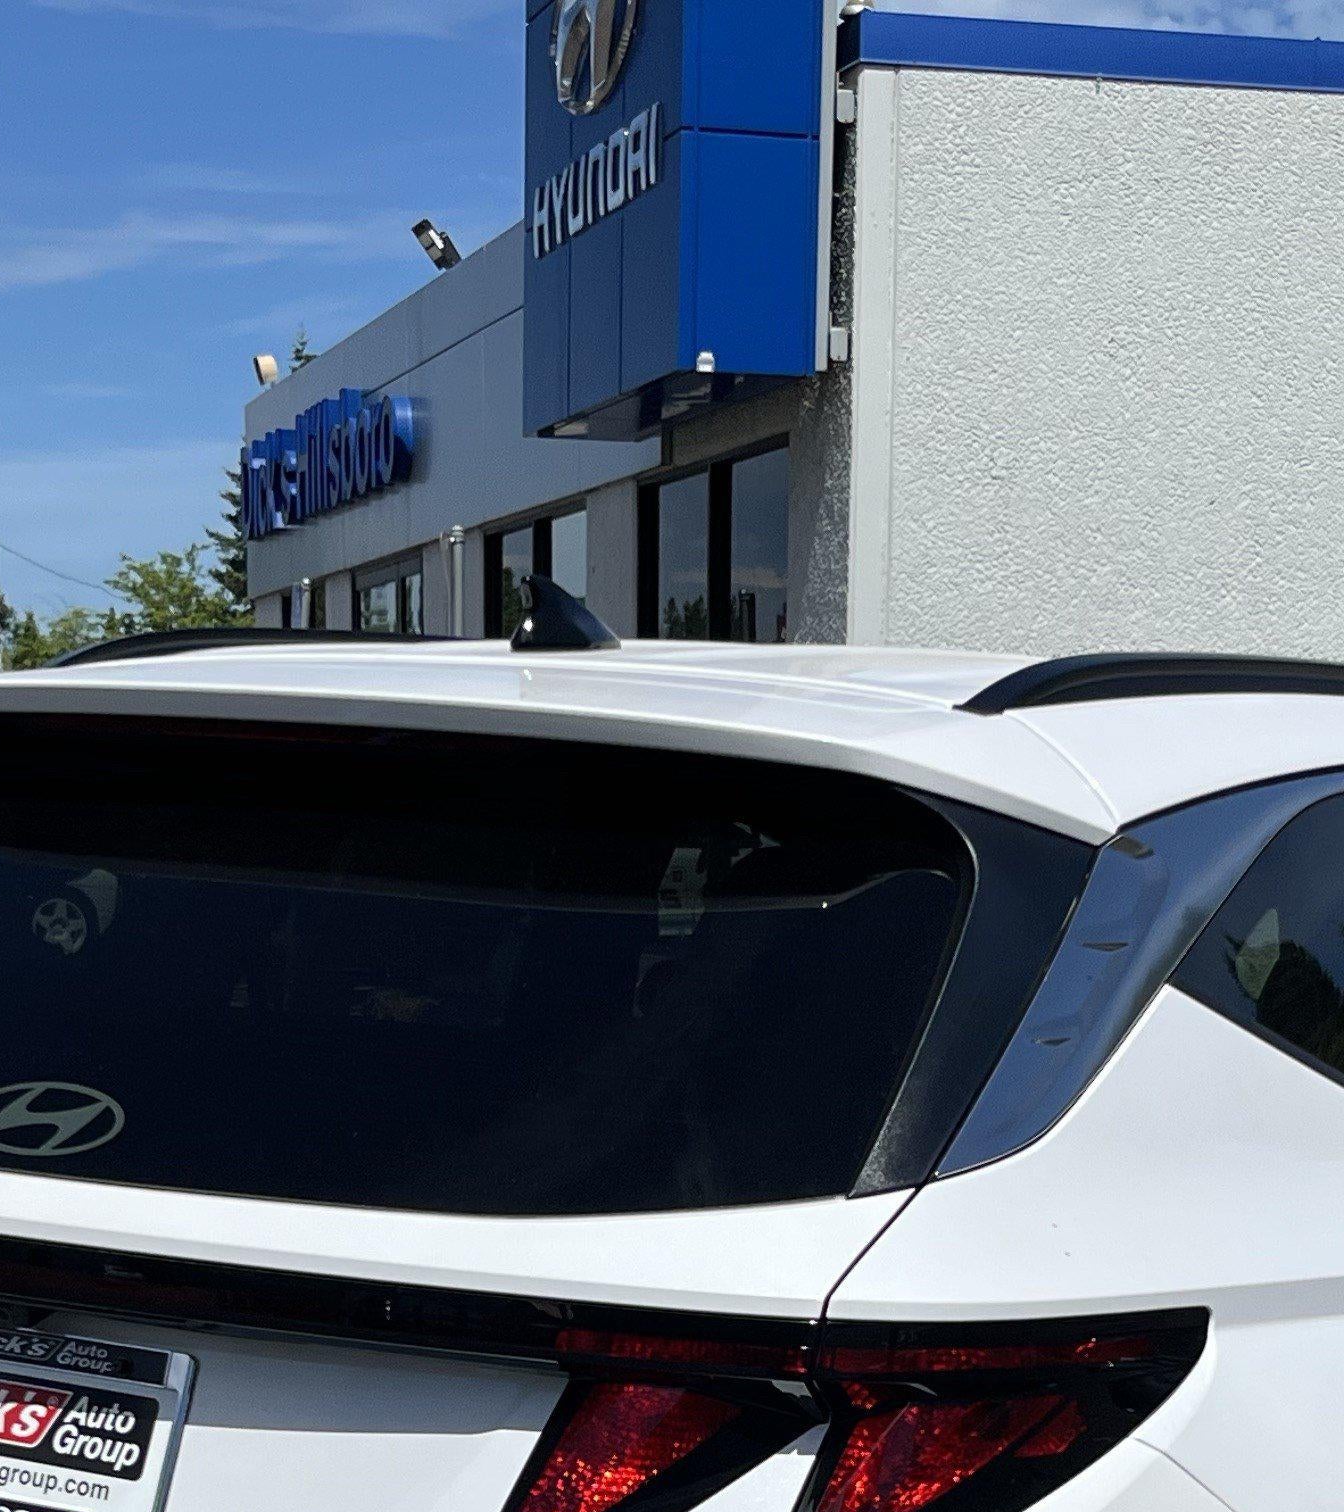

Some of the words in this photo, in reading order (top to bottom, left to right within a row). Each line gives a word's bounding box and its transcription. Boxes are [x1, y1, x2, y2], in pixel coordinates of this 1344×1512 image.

[532, 101, 661, 260] HYUNDAI
[56, 1351, 114, 1373] Group
[63, 1340, 109, 1358] Auto
[62, 1395, 136, 1434] Auto
[52, 1424, 141, 1471] Group
